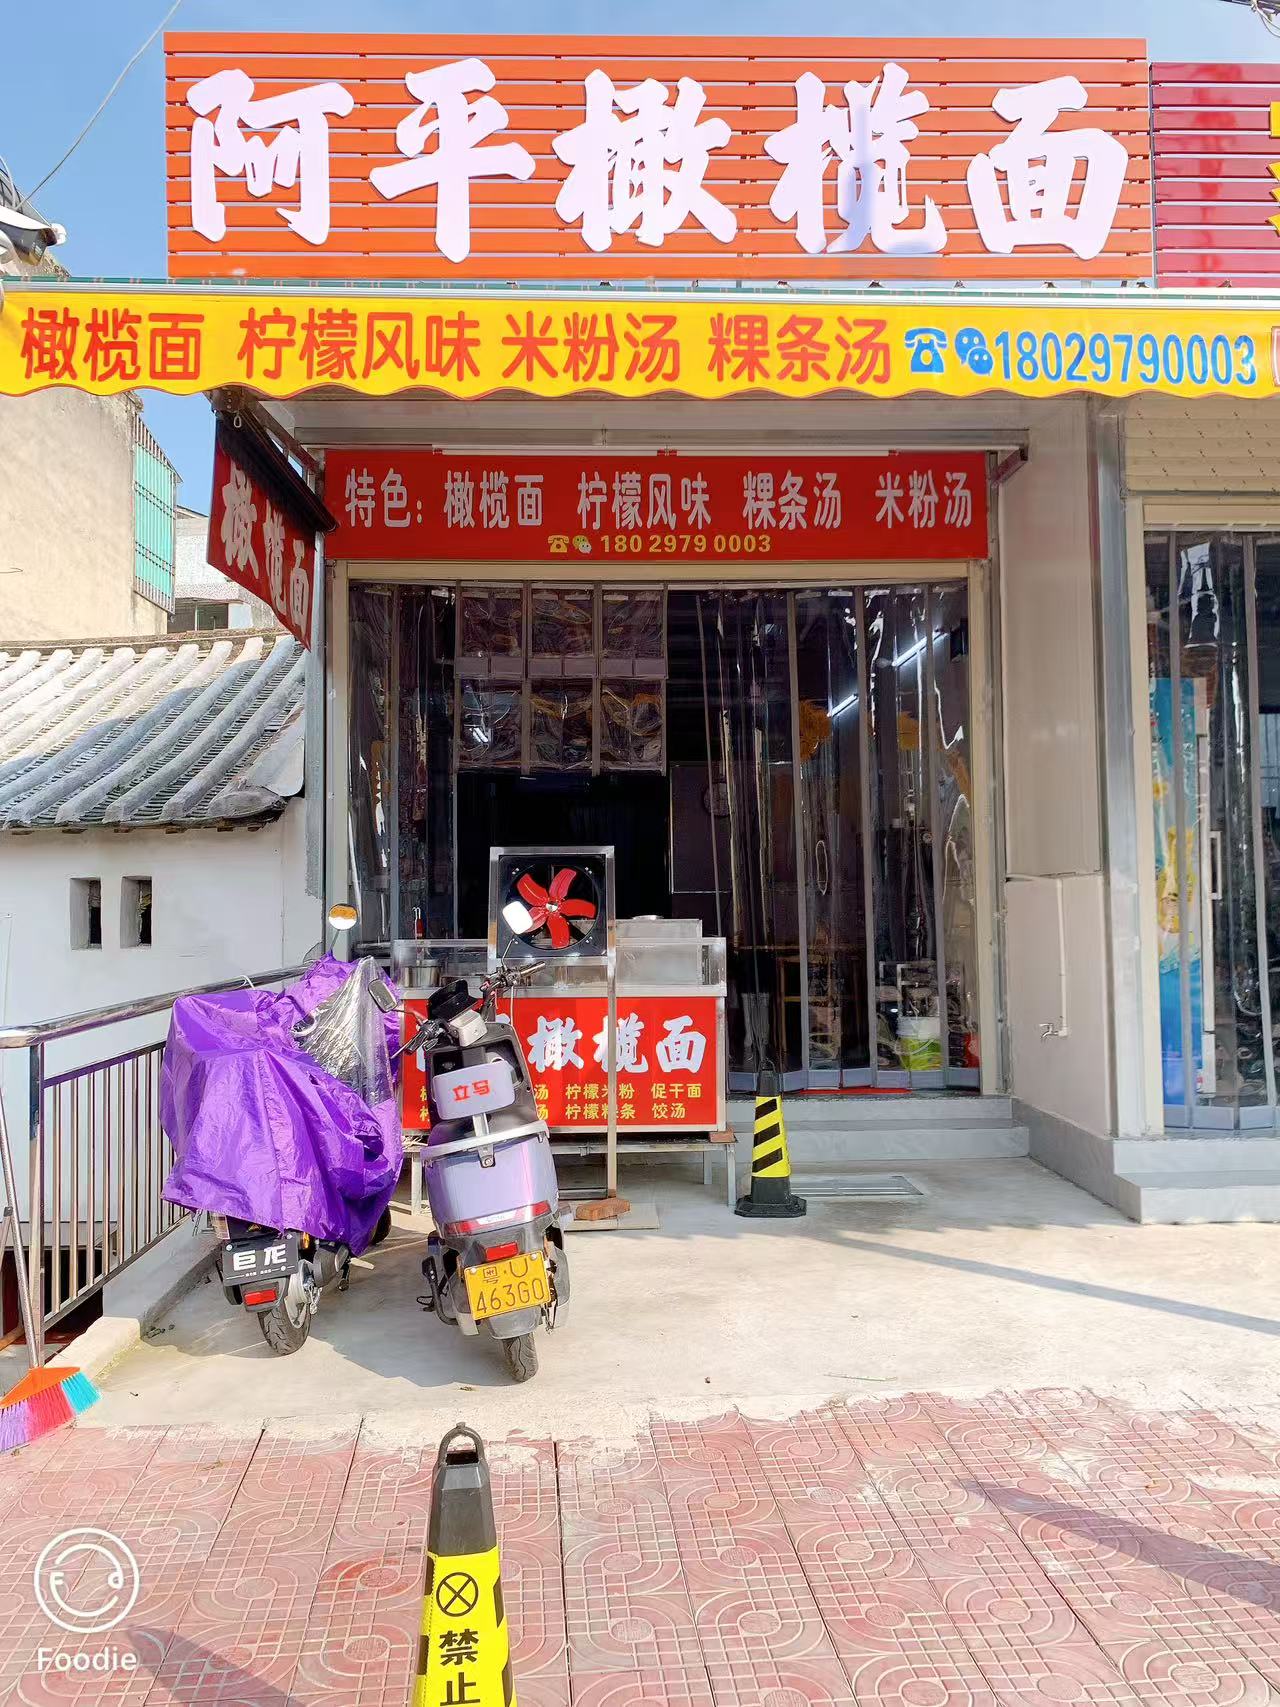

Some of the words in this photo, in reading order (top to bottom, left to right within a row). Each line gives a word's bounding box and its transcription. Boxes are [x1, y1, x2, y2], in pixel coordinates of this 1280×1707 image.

[186, 57, 1130, 262] 阿平橄榄面
[20, 306, 205, 382] 橄榄面
[237, 307, 481, 382] 柠檬风味
[501, 311, 681, 383] 米粉汤
[707, 313, 891, 385] 粿条汤
[994, 330, 1258, 385] 18029790003
[443, 469, 545, 529] 橄榄面
[577, 471, 712, 530] 柠檬风味
[742, 470, 842, 531] 粿条汤
[875, 470, 973, 530] 米粉汤
[601, 534, 643, 553] 180
[649, 534, 707, 553] 2979
[713, 534, 772, 553] 0003
[527, 1012, 707, 1074] 橄榄面
[452, 1080, 491, 1101] 立马
[650, 1083, 702, 1099] 促干面
[651, 1102, 686, 1119] 饺汤
[438, 1628, 481, 1707] 禁止
